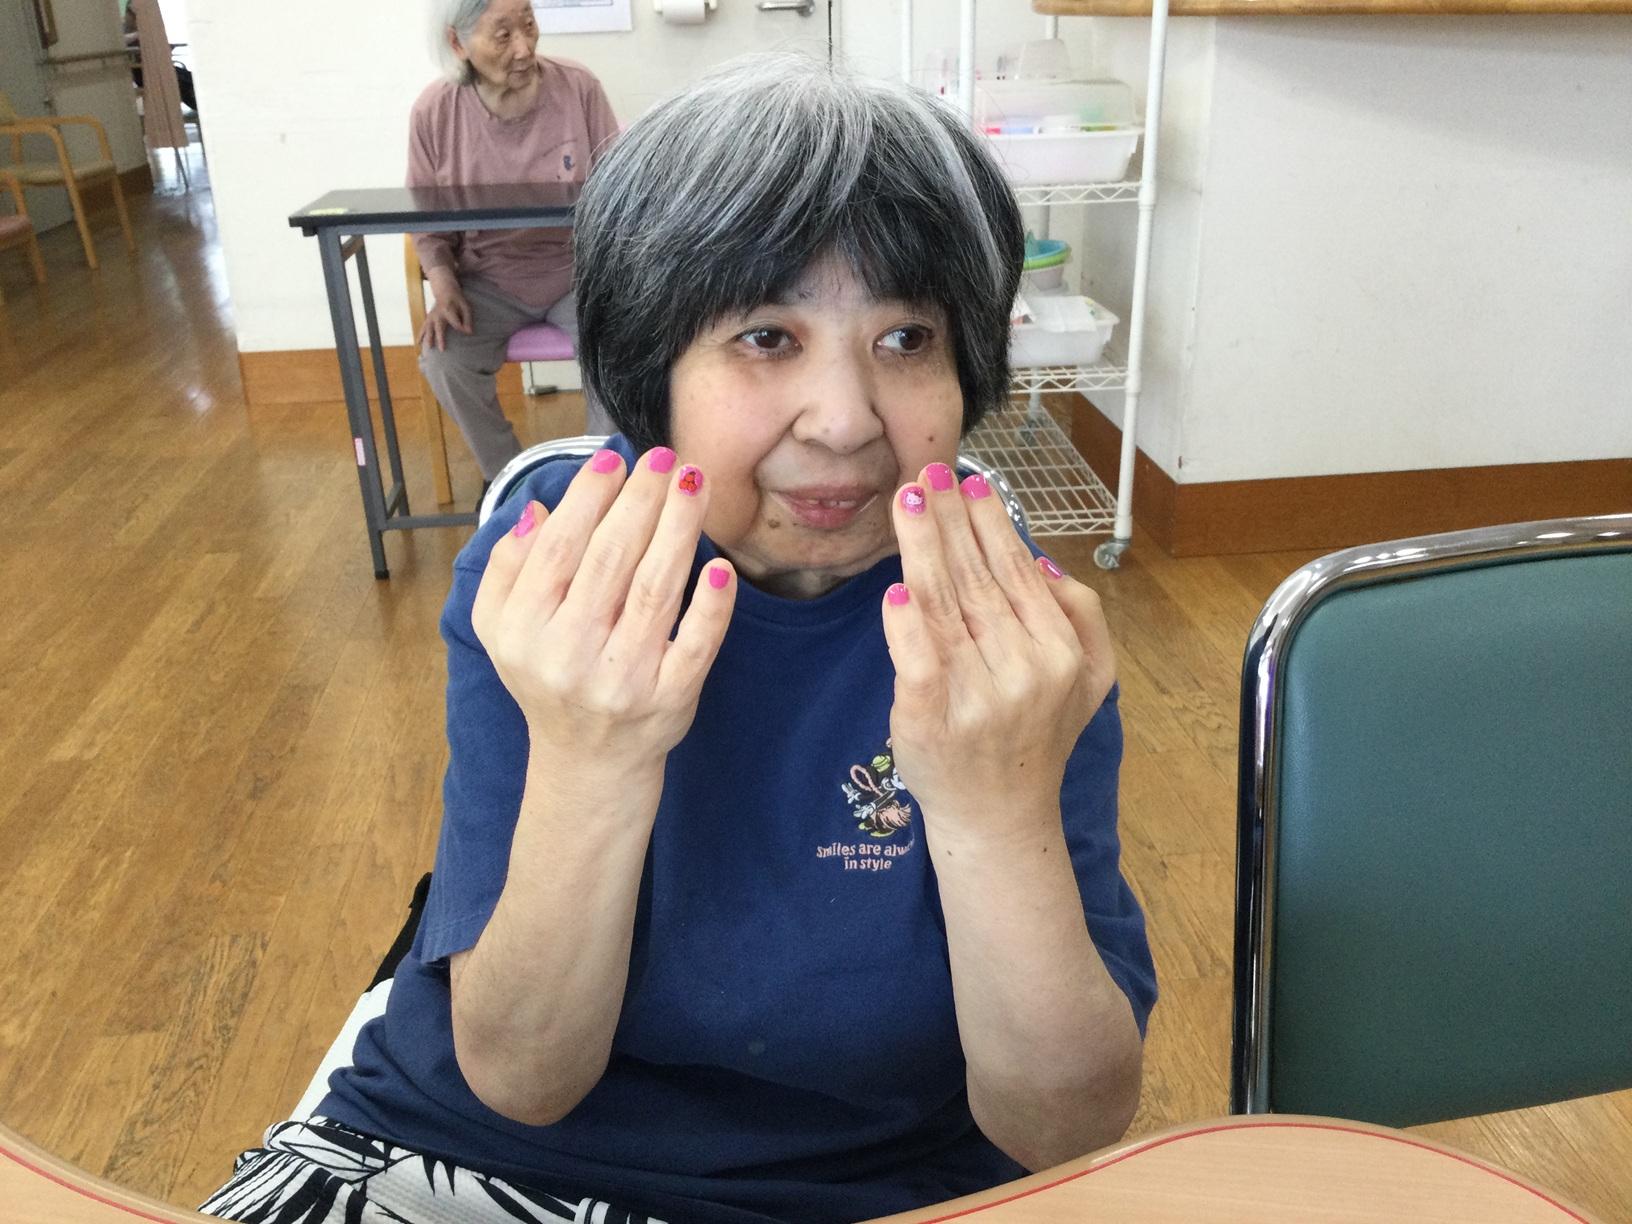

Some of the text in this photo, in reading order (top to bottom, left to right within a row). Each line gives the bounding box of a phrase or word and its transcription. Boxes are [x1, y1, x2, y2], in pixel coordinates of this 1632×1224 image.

[859, 843, 881, 856] are
[844, 857, 892, 871] in style
